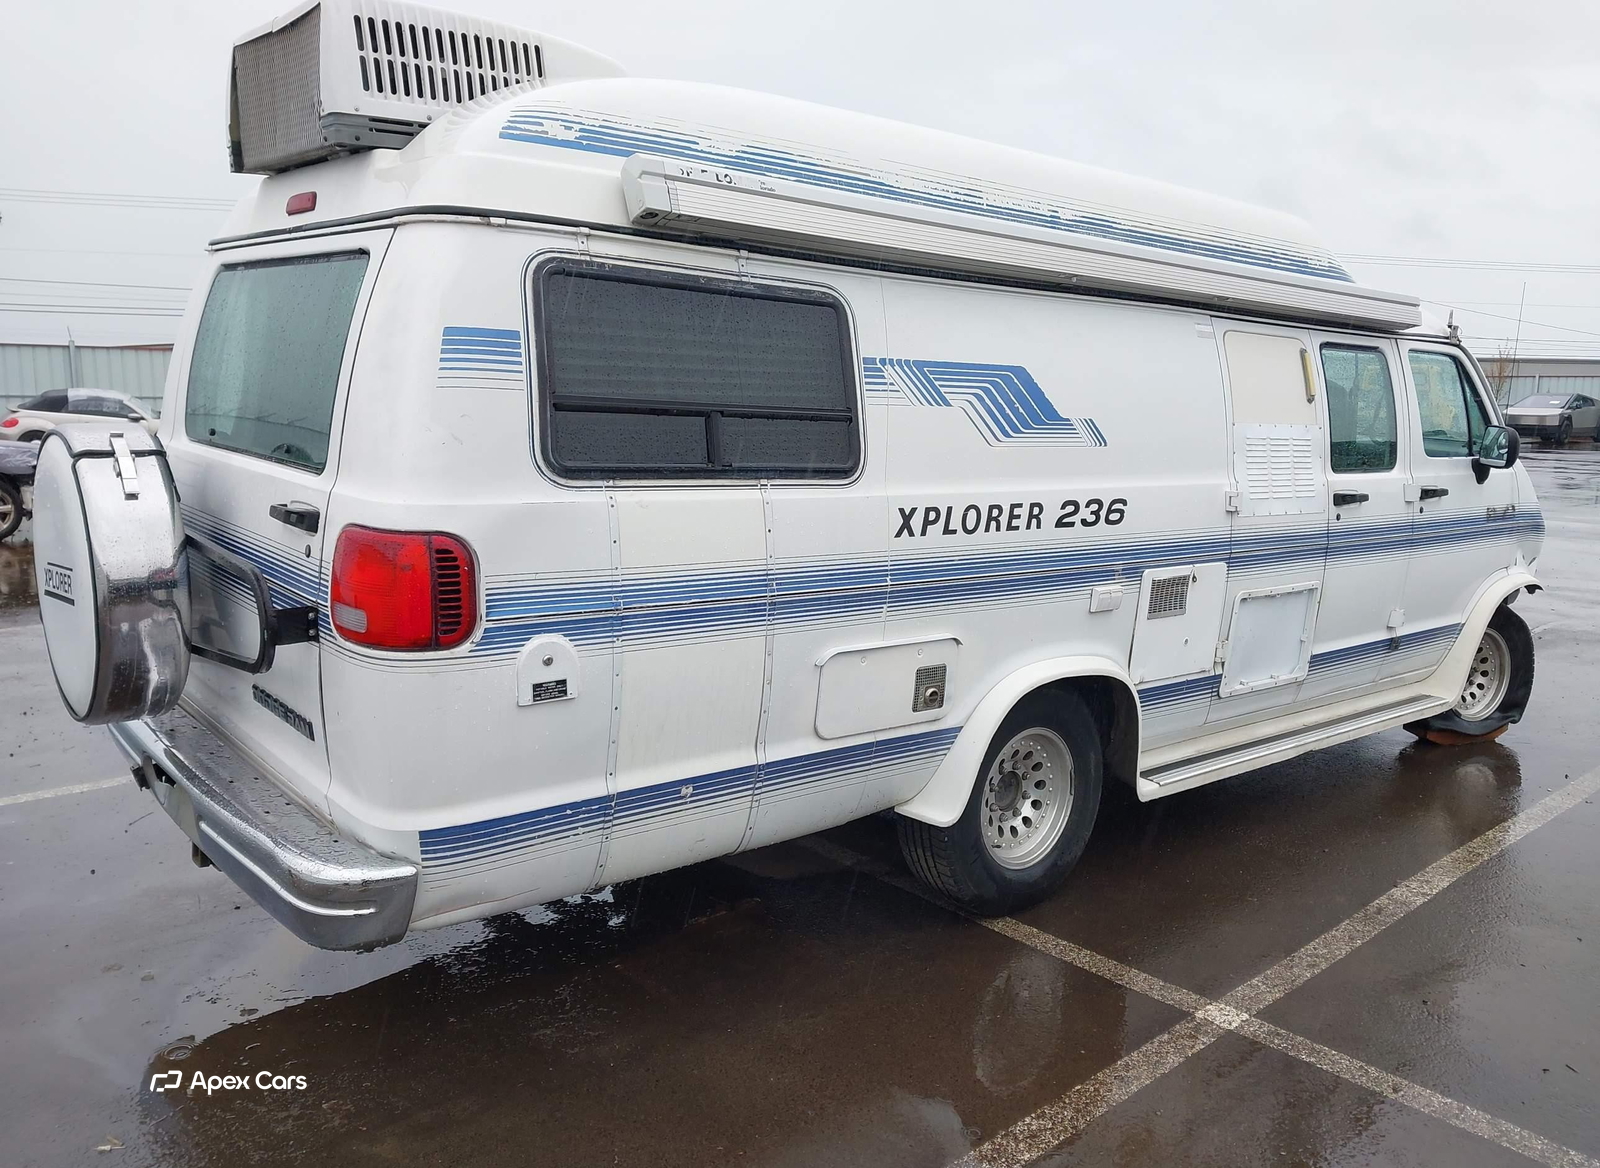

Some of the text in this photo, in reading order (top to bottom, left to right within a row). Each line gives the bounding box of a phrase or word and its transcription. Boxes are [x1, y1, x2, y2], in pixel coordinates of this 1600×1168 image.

[894, 498, 1128, 538] XPLORER 236
[44, 567, 73, 596] XPLORER
